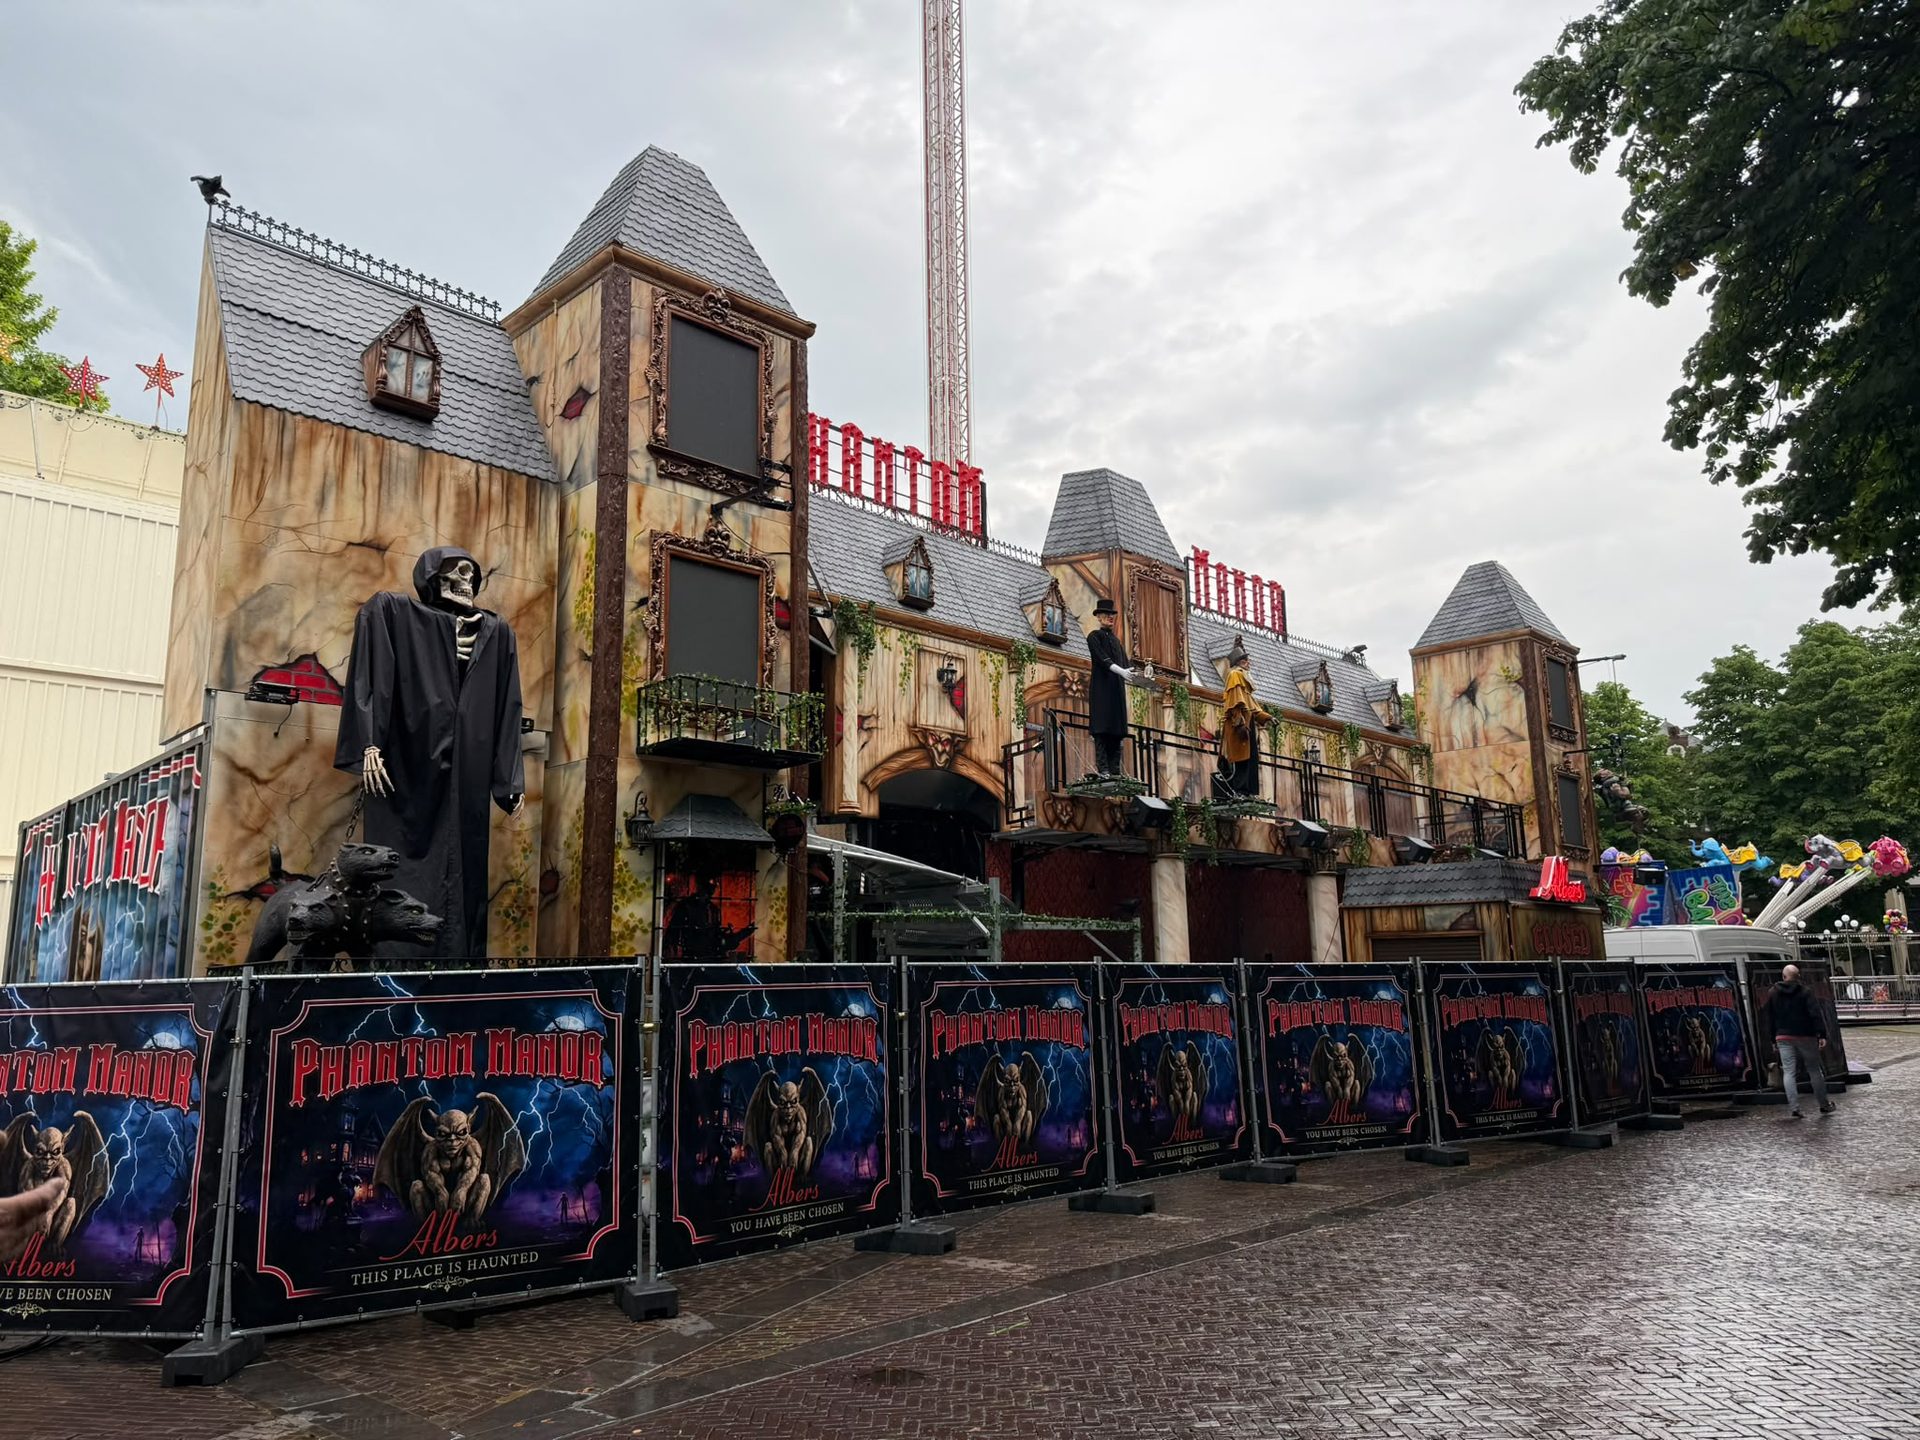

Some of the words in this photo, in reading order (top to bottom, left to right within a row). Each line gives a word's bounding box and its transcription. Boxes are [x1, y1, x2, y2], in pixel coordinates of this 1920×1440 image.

[1191, 545, 1285, 634] MANOR
[1533, 921, 1591, 956] CLOSED
[930, 1007, 1021, 1060] PHANTOM
[1024, 1005, 1085, 1052] MANOR
[1120, 1001, 1186, 1047] PHANTOM
[1186, 999, 1233, 1041] MANOR
[1267, 998, 1346, 1038] PHANTOM
[1347, 996, 1405, 1034] MANOR
[688, 1015, 801, 1079] PHANTOM
[806, 1012, 878, 1066] MANOR
[83, 1043, 196, 1116] MANOR
[289, 1031, 477, 1107] PHANTOM
[484, 1027, 604, 1089] MANOR
[1316, 1098, 1367, 1125] Albers
[1306, 1130, 1320, 1139] YOU
[1322, 1129, 1340, 1137] HAVE
[1342, 1127, 1359, 1136] BEEN
[1360, 1125, 1387, 1134] CHOSEN
[981, 1135, 1038, 1172] Albers
[1153, 1151, 1166, 1160] YOU
[1166, 1148, 1181, 1158] HAVE
[748, 1167, 820, 1211] Albers
[968, 1180, 987, 1190] THIS
[989, 1175, 1013, 1187] PLACE
[1014, 1174, 1022, 1182] IS
[1023, 1167, 1060, 1181] HAUNTED
[378, 1208, 498, 1261] Albers
[730, 1220, 752, 1233] YOU
[755, 1216, 781, 1229] HAVE
[782, 1210, 806, 1224] BEEN
[808, 1202, 844, 1218] CHOSEN
[351, 1270, 388, 1286] THIS
[394, 1263, 443, 1281] PLACE
[449, 1261, 462, 1274] IS
[467, 1251, 539, 1272] HAUNTED
[18, 1288, 53, 1300] BEEN
[56, 1288, 113, 1300] CHOSEN
